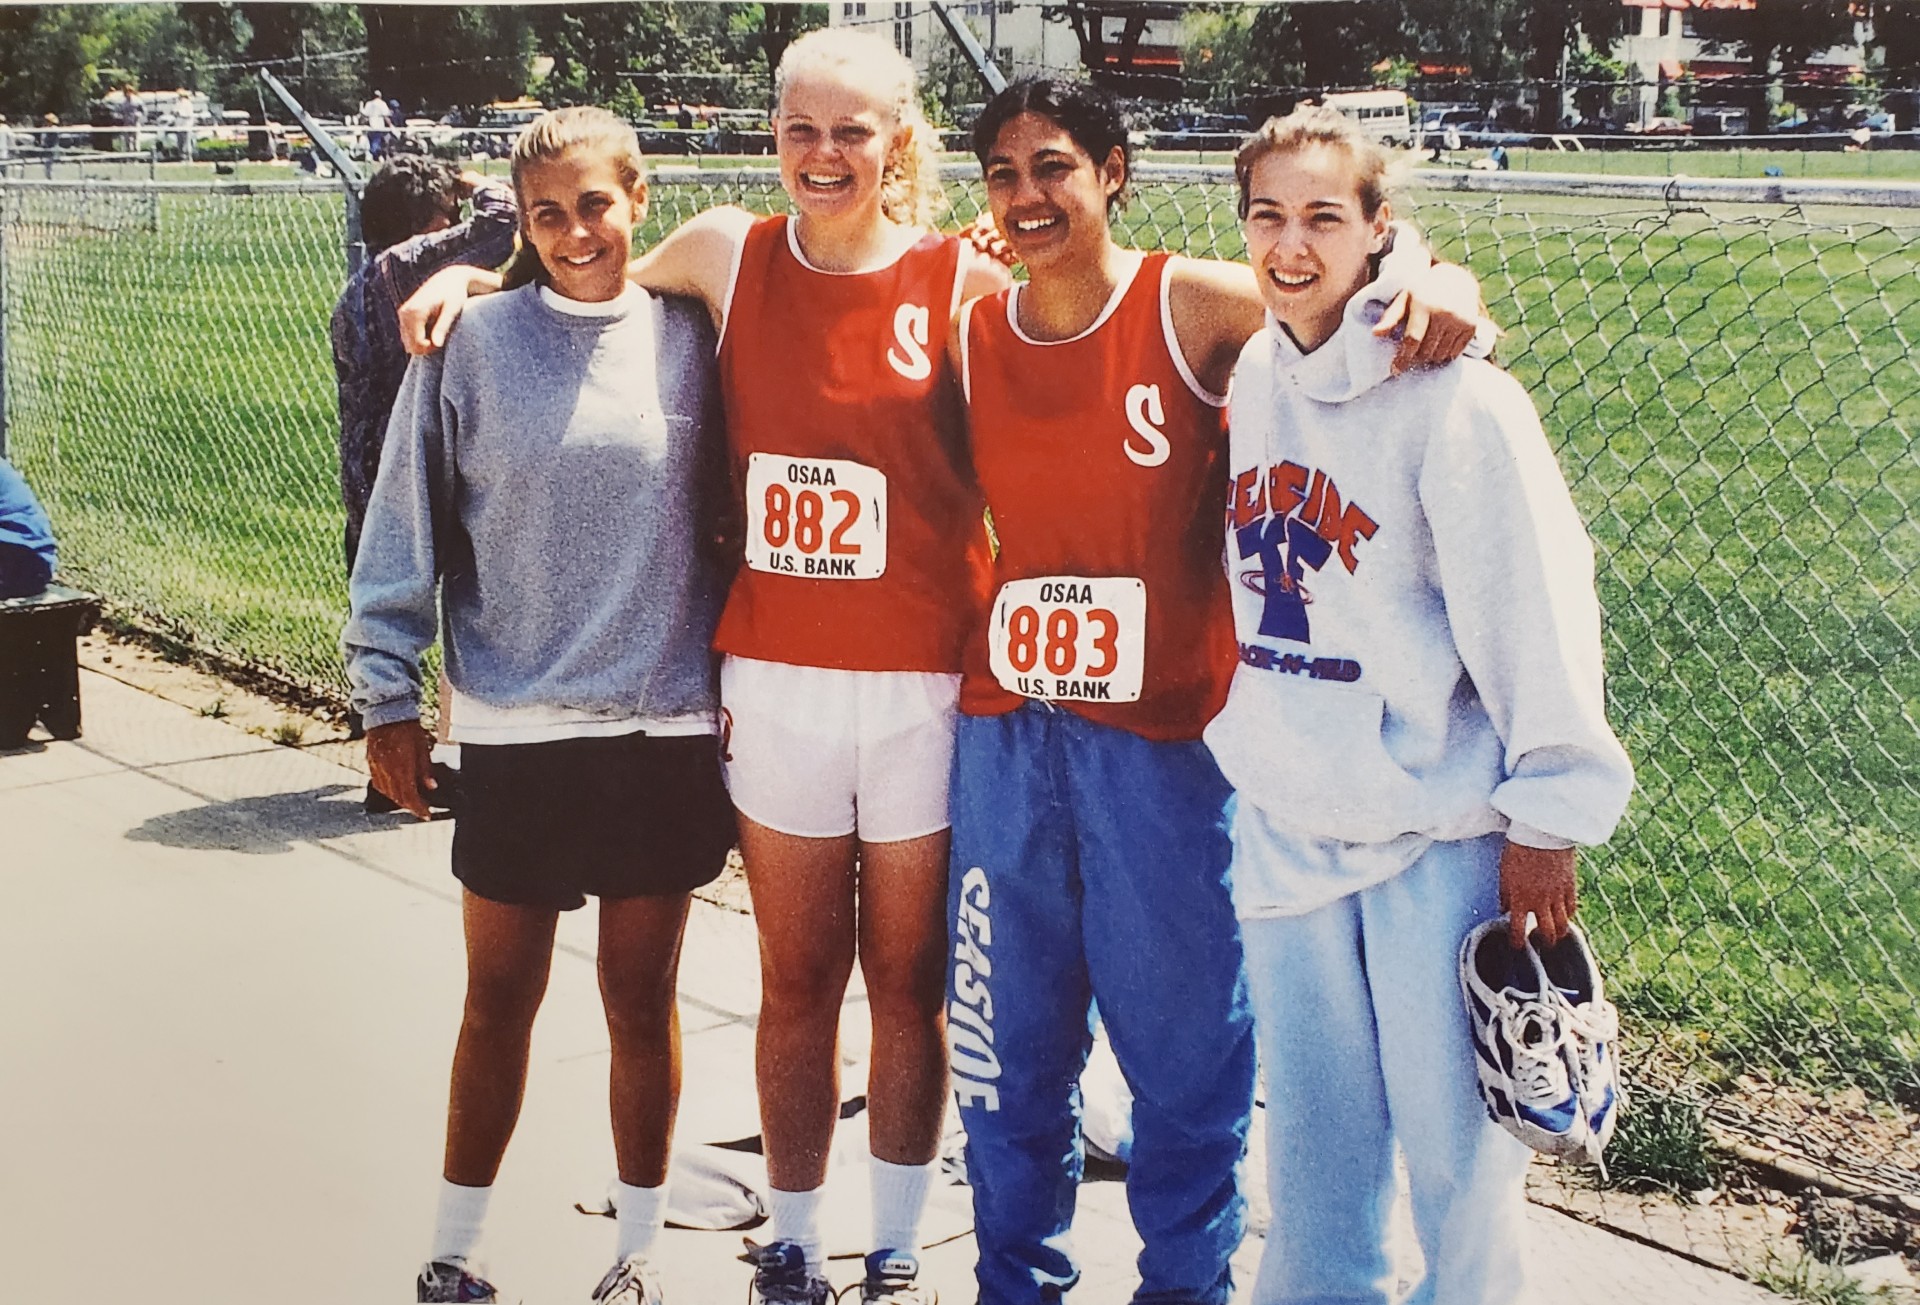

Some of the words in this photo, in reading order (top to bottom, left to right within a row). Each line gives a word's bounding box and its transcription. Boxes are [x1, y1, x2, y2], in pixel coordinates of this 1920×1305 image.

[887, 303, 931, 380] S
[1123, 384, 1170, 467] S
[788, 463, 836, 486] OSAA
[764, 483, 861, 555] 882
[770, 552, 798, 573] U.S.
[804, 558, 856, 576] BANK
[1040, 583, 1093, 604] OSAA
[1008, 605, 1119, 678] 883
[1017, 677, 1049, 697] U.S.
[1056, 680, 1111, 700] BANK
[948, 867, 1003, 1112] SEASIDE
